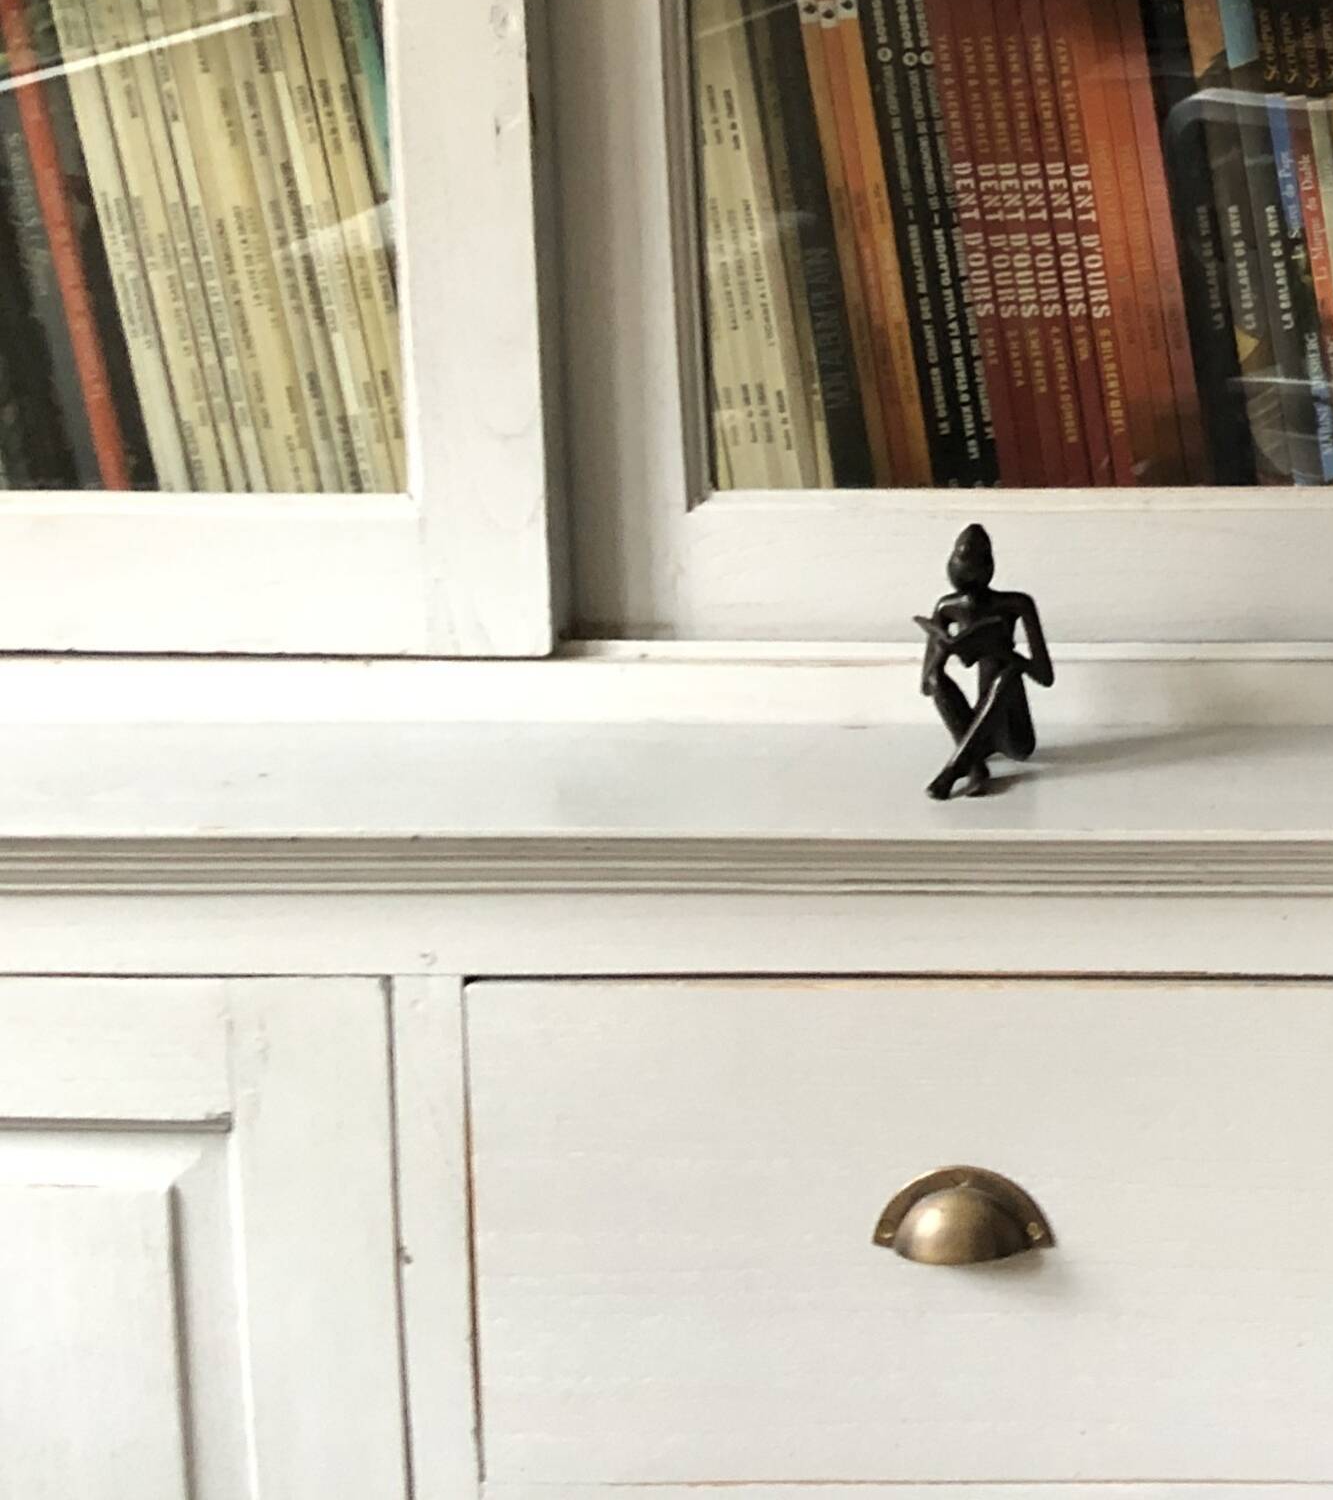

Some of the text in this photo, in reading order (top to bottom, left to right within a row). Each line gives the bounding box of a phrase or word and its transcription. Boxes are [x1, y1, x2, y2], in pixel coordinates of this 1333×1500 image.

[1253, 7, 1280, 82] SCORPION
[1274, 10, 1302, 85] SCORPION
[950, 159, 981, 223] DENT
[974, 161, 1005, 224] DENT
[995, 159, 1026, 224] DENT
[1017, 160, 1048, 224] DENT
[1042, 159, 1073, 223] DENT
[1068, 161, 1098, 226] DENT
[1298, 152, 1317, 197] Diable
[1226, 202, 1244, 237] YAYA
[1263, 202, 1282, 237] YAYA
[1306, 215, 1329, 260] Marque
[931, 226, 954, 287] GLAUQUE
[961, 232, 996, 318] D'OURS
[986, 232, 1020, 320] D'OURS
[1007, 232, 1042, 319] D'OURS
[1028, 231, 1064, 319] D'OURS
[1053, 230, 1088, 319] D'OURS
[1078, 231, 1113, 320] D'OURS
[1235, 258, 1256, 310] BALADE
[1273, 259, 1294, 310] BALADE
[916, 295, 935, 321] DES
[941, 286, 959, 319] VILLE
[1243, 312, 1260, 332] LA
[1280, 311, 1297, 331] LA
[920, 321, 941, 364] CHANT
[1302, 330, 1326, 391] DESBERG
[927, 365, 951, 419] DERNIER
[950, 355, 973, 404] D'ÉTAIN
[959, 403, 978, 437] YEUX
[965, 437, 981, 459] LES
